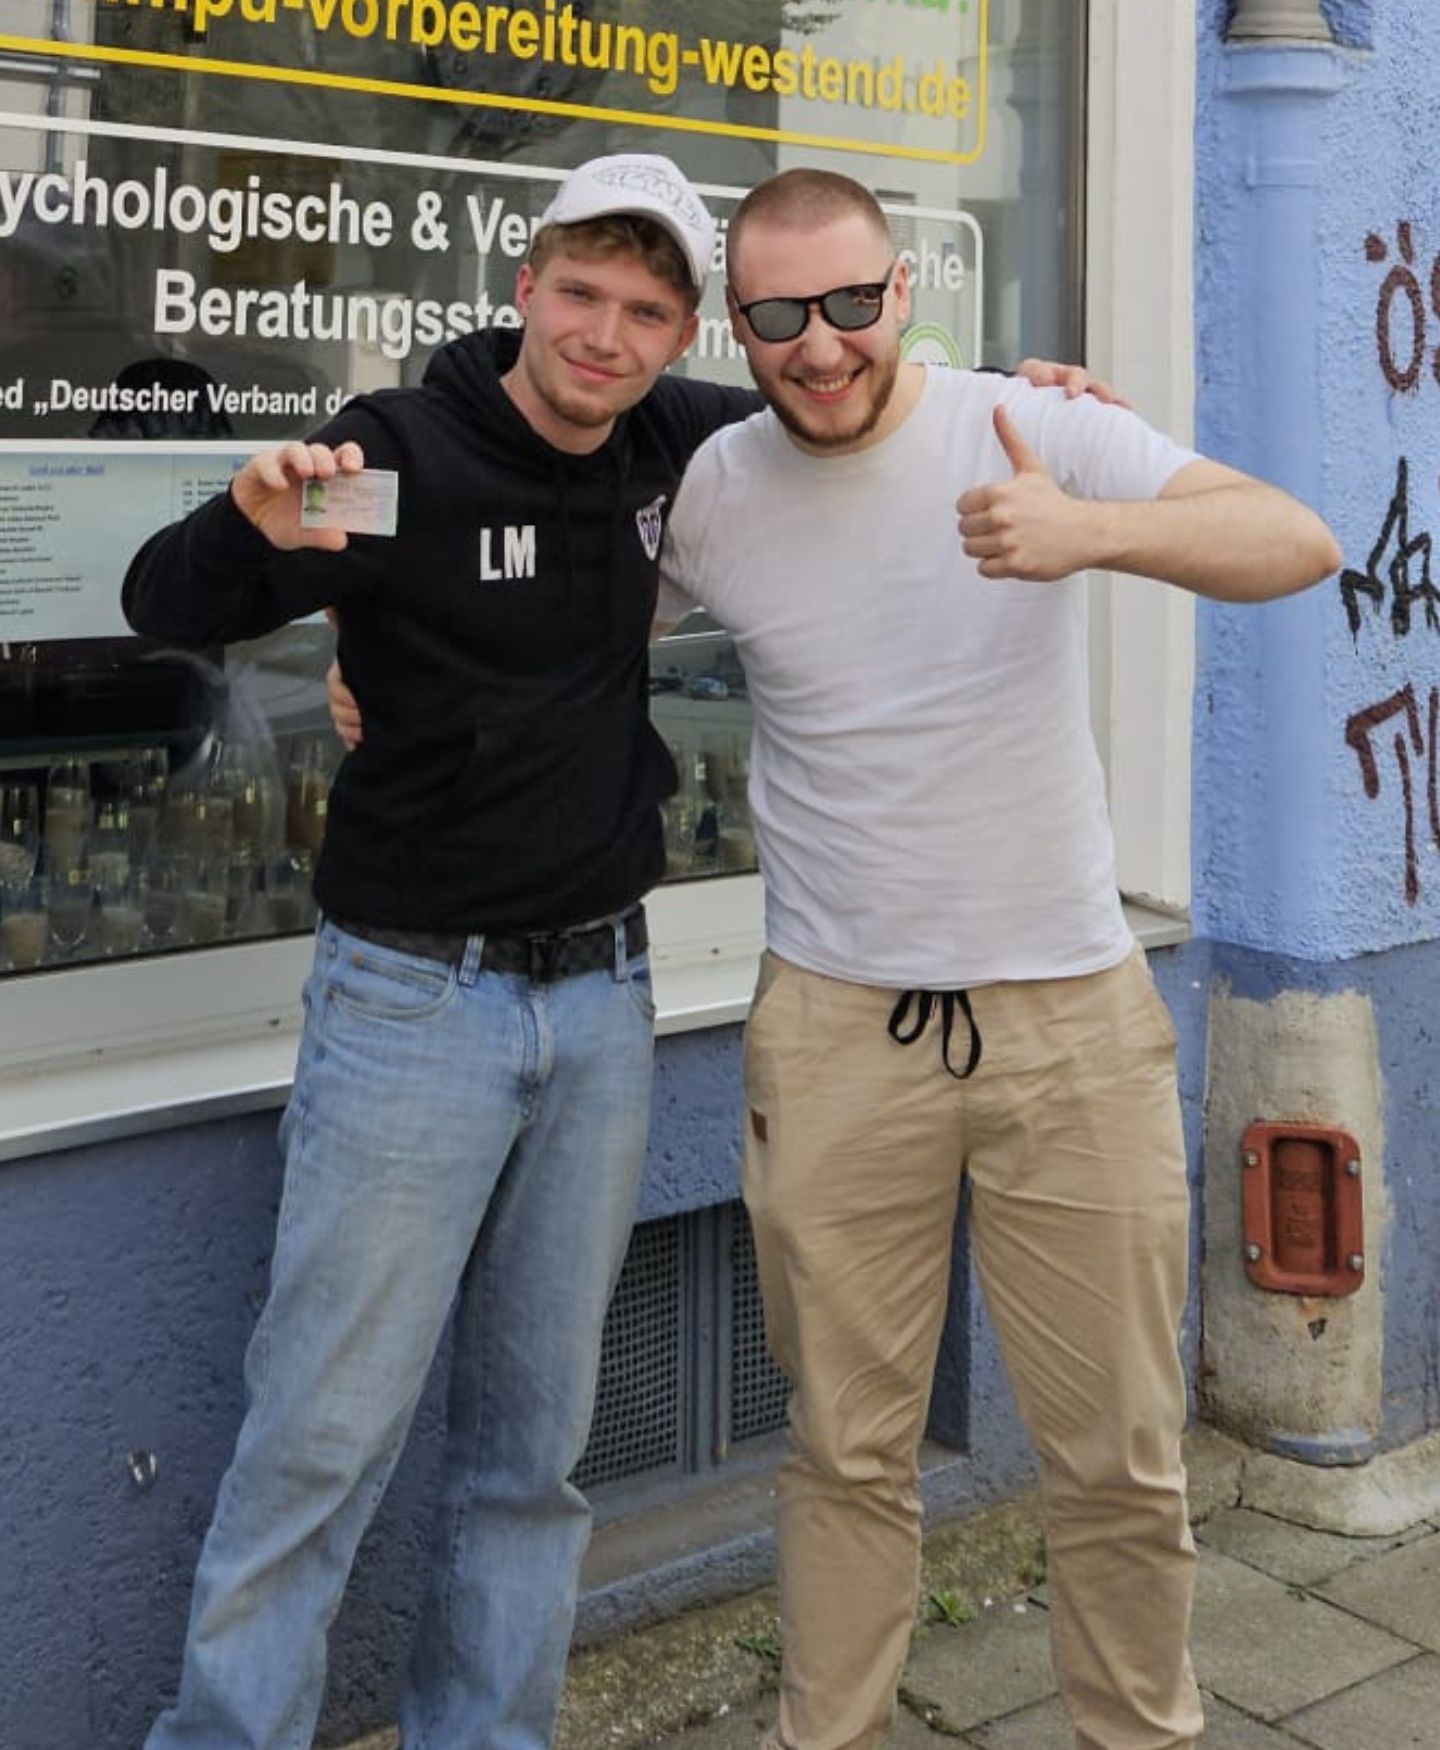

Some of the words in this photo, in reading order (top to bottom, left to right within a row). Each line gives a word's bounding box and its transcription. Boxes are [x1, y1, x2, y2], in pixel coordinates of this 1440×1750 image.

[126, 0, 971, 119] pu-vorbereitung-westend.de
[411, 190, 450, 252] &
[34, 379, 199, 416] „Deutscher
[206, 383, 317, 415] Verband
[480, 525, 536, 580] LM
